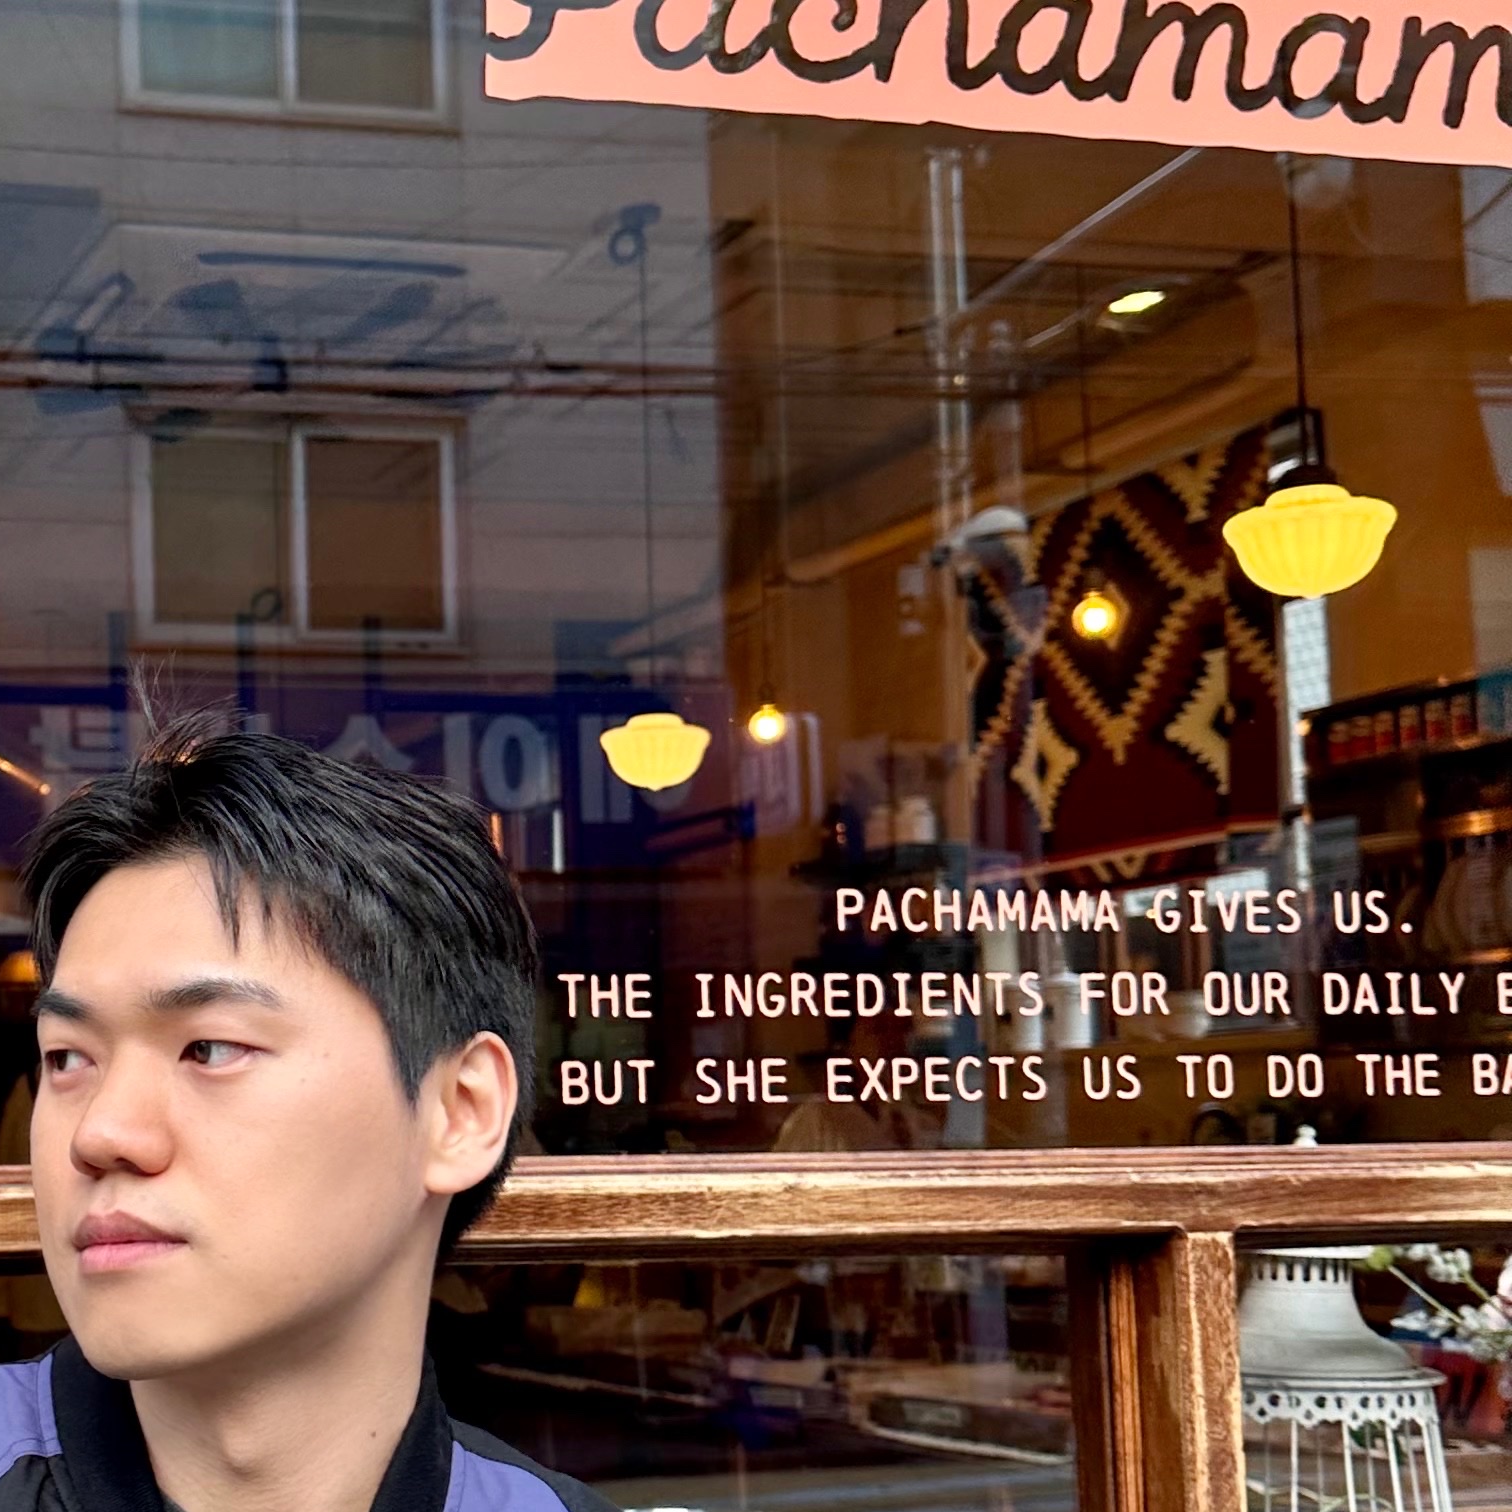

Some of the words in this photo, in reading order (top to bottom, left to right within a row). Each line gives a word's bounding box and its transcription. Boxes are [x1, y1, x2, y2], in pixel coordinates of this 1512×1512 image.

[836, 887, 1120, 933] PACHAMAMA
[1154, 888, 1302, 934] GIVES
[1333, 890, 1414, 935] US.
[557, 973, 652, 1018] THE
[694, 971, 1045, 1018] INGREDIENTS
[1078, 971, 1170, 1016] FOR
[1199, 971, 1291, 1016] OUR
[1322, 971, 1465, 1016] DAILY
[561, 1059, 655, 1105] BUT
[695, 1058, 788, 1104] SHE
[826, 1055, 1047, 1102] EXPECTS
[1083, 1055, 1141, 1100] US
[1176, 1054, 1234, 1099] TO
[1267, 1053, 1324, 1098] DO
[1355, 1053, 1442, 1097] THE
